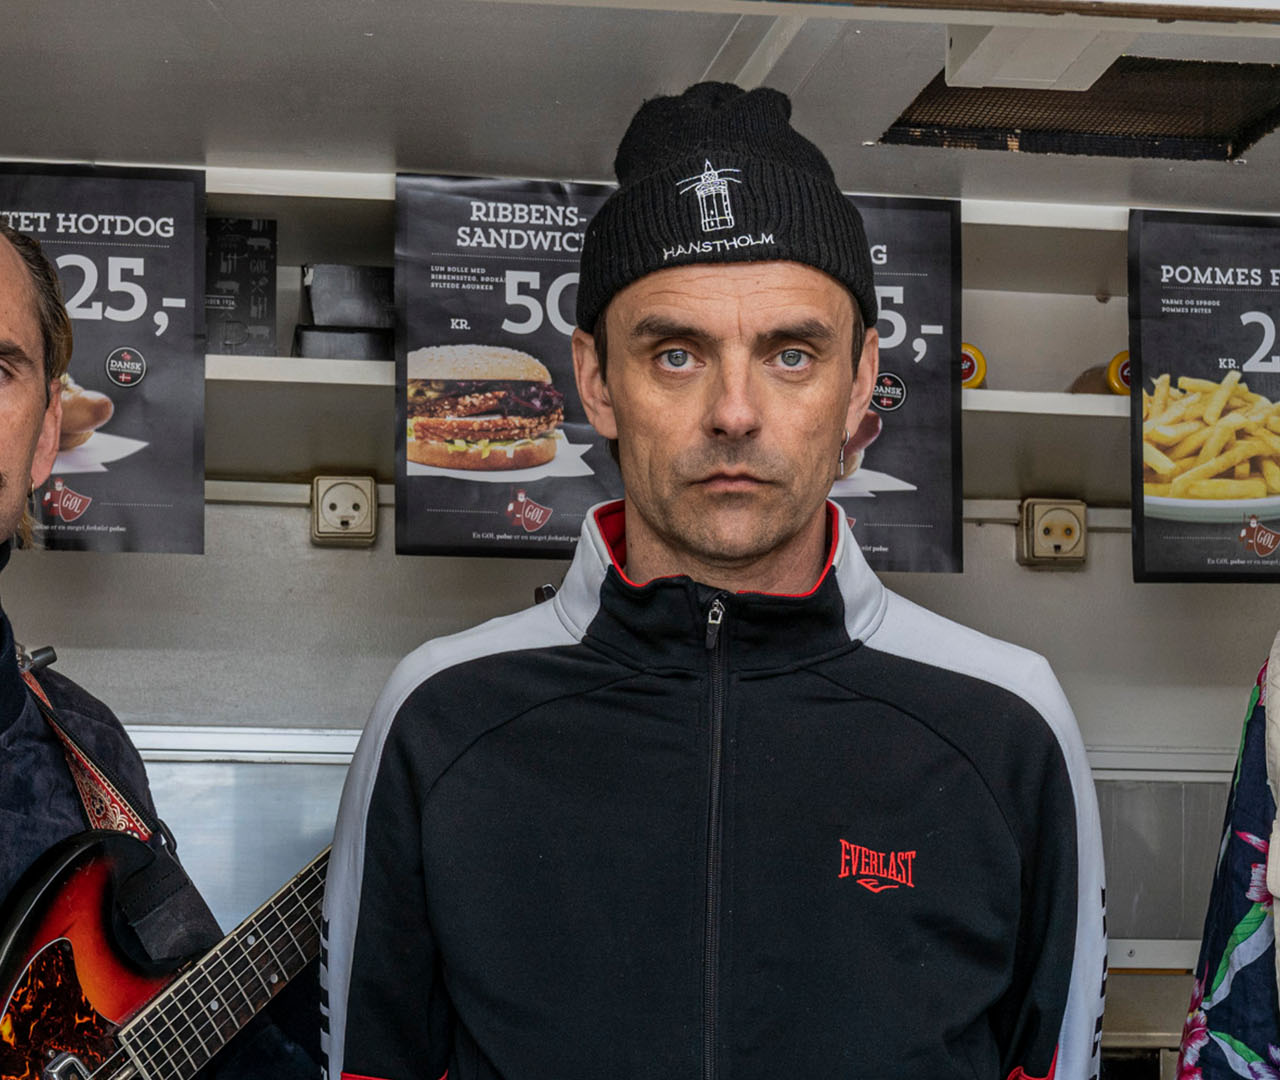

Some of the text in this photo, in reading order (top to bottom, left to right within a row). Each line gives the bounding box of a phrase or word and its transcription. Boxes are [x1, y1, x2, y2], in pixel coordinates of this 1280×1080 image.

[470, 201, 587, 227] RIBBENS-
[56, 213, 174, 238] HOTDOG
[457, 226, 586, 252] SANDWIC
[663, 233, 774, 260] HANSTHOLM
[1160, 264, 1263, 286] POMMES
[55, 254, 186, 337] 25,-
[450, 318, 471, 330] KR.
[110, 360, 142, 370] DANSK
[1218, 358, 1240, 369] KR.
[62, 493, 83, 514] GØL
[524, 504, 544, 524] GØL
[1256, 530, 1275, 549] GØL
[838, 838, 917, 888] EVERLAST
